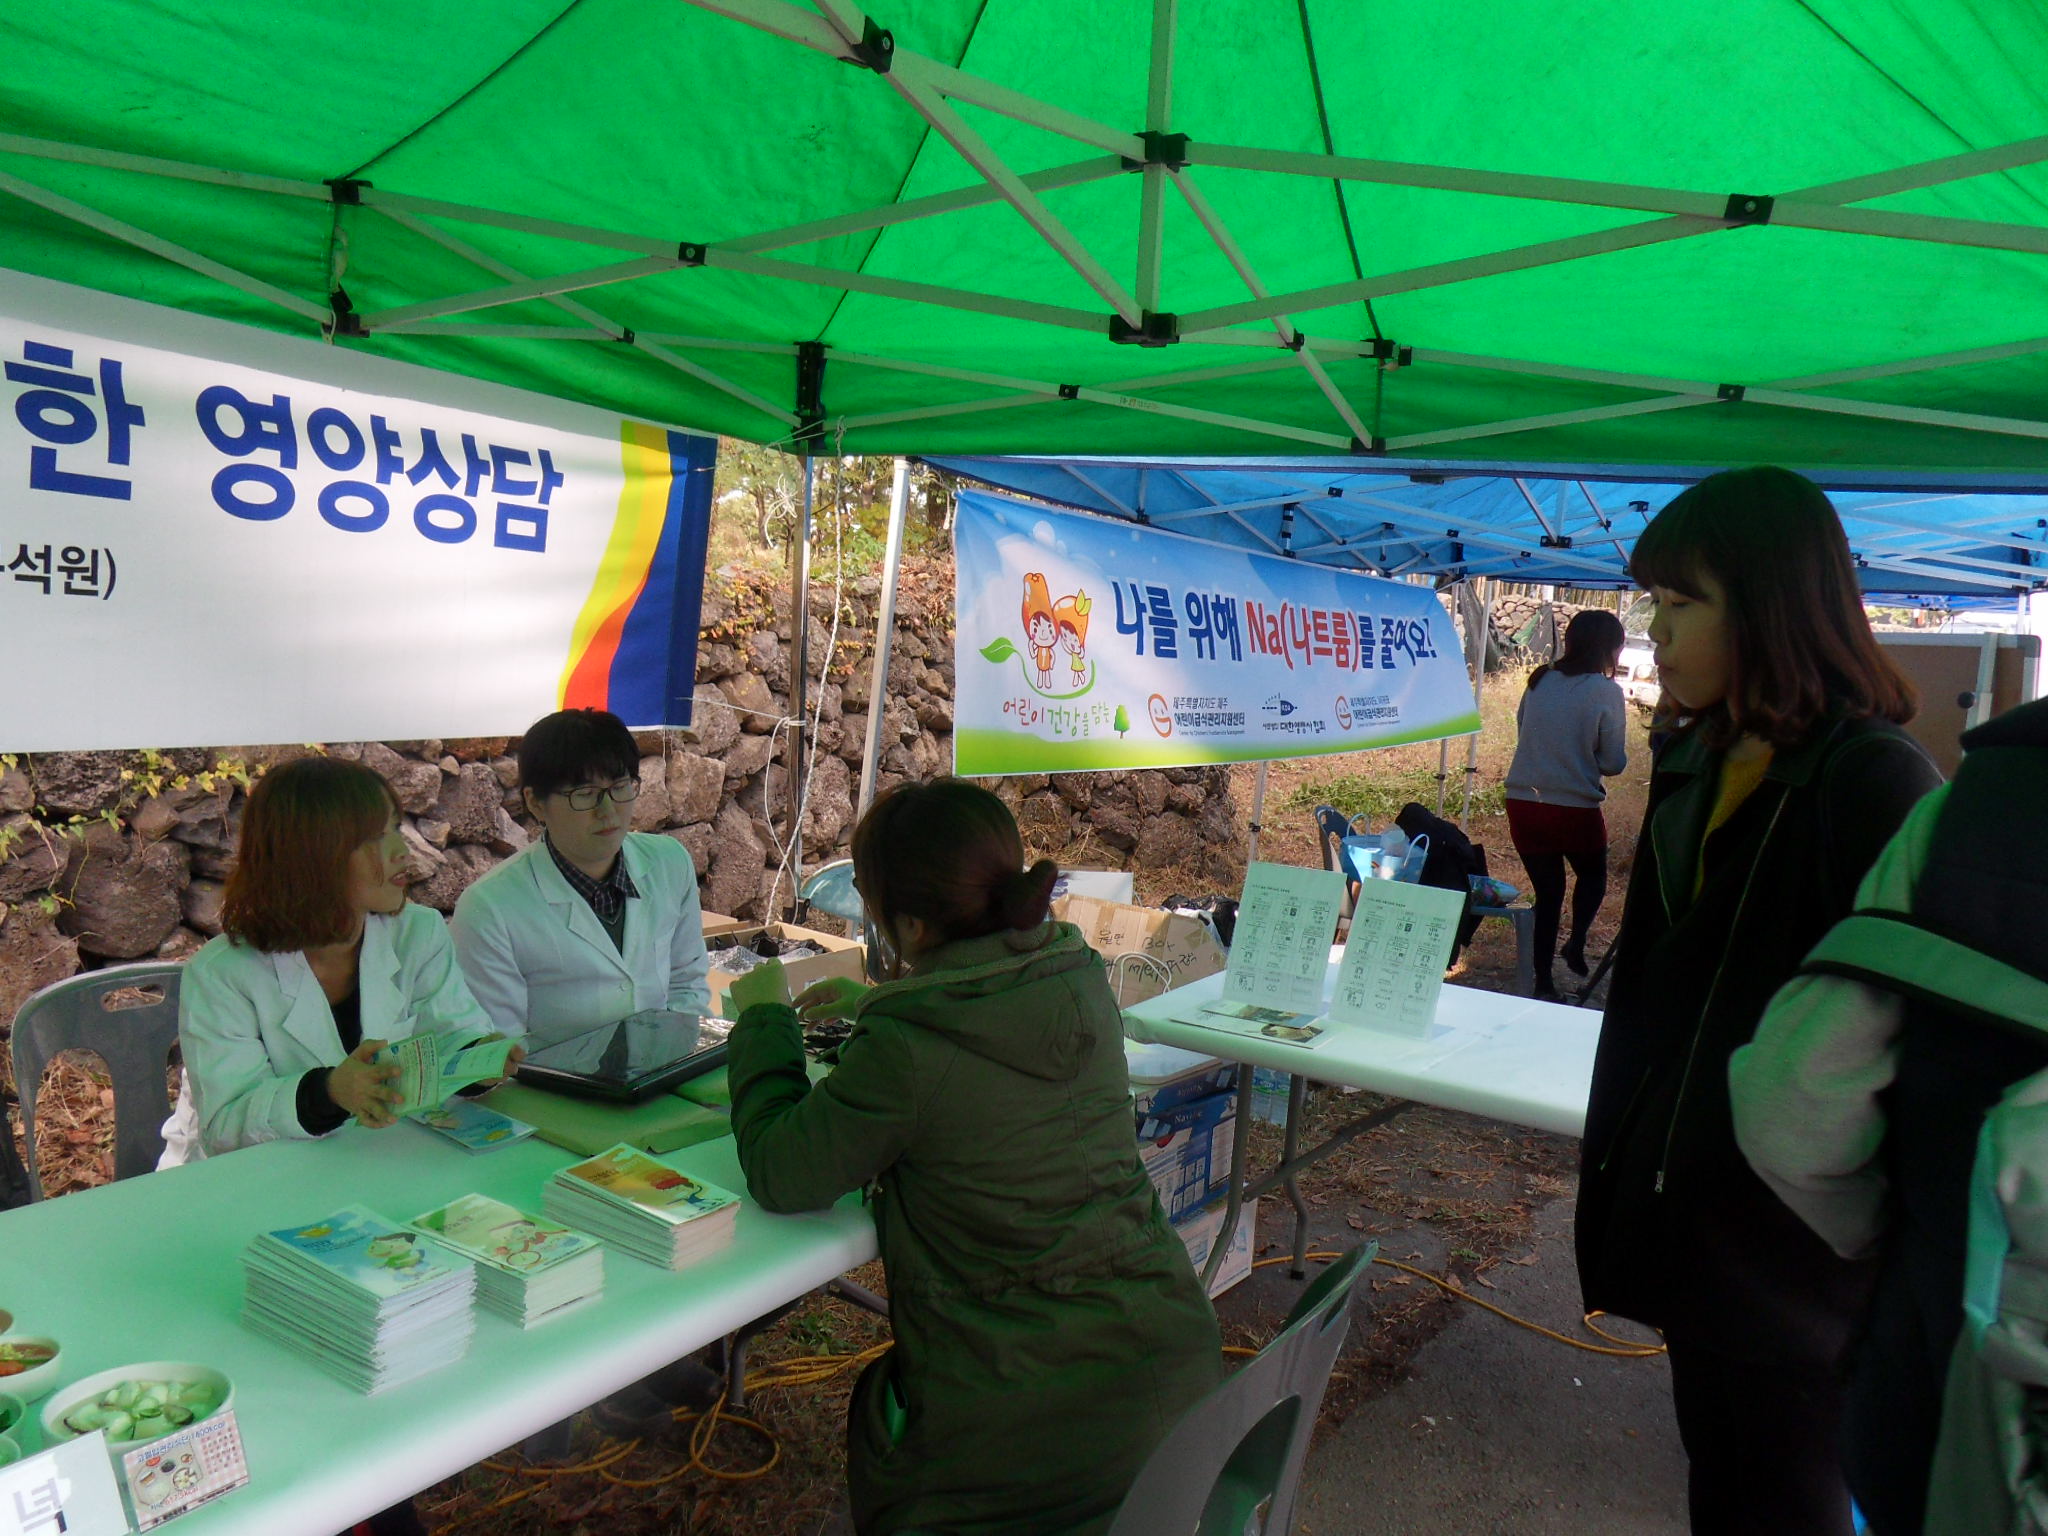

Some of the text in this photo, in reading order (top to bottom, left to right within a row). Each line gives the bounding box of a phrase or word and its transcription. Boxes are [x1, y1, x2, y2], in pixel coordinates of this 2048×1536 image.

[5, 340, 564, 553] 한 영양상담
[0, 544, 117, 600] 석원)
[1112, 581, 1437, 673] 나를 위해 Na(나트륨)를 줄여요!
[1003, 697, 1044, 726] 어린이
[1047, 704, 1089, 737] 건강을
